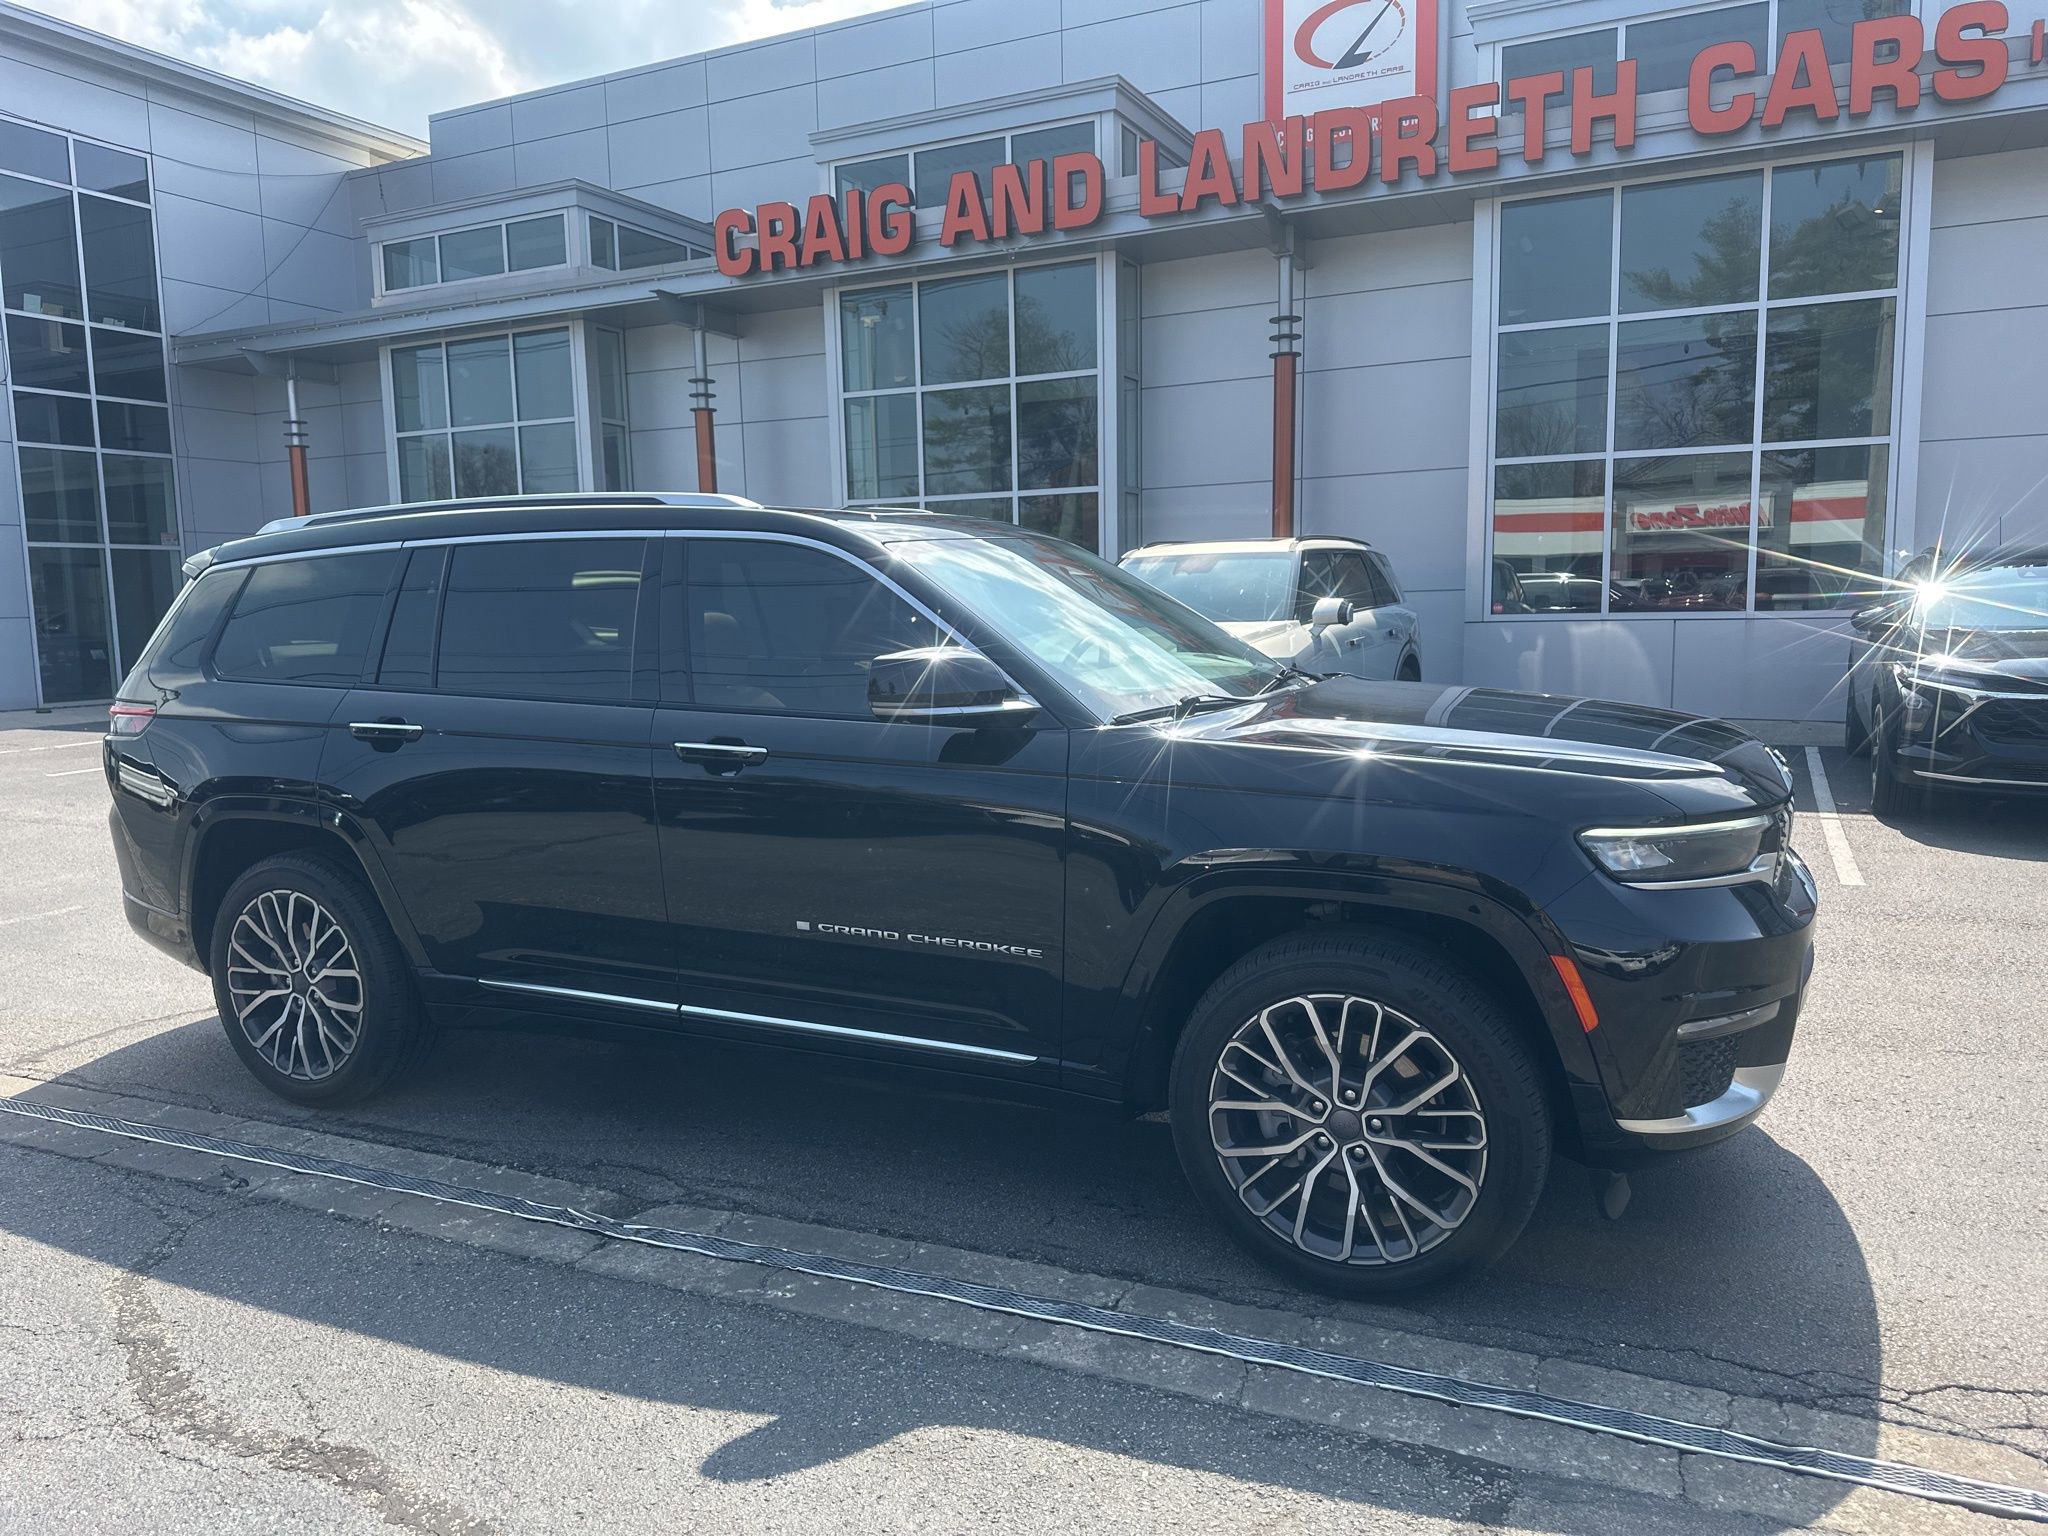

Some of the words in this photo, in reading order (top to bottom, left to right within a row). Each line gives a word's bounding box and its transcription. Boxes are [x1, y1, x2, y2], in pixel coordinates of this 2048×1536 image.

[1332, 69, 1378, 83] LANDRETH
[713, 183, 915, 277] CRAIG
[940, 152, 1105, 248] AND
[1139, 58, 1637, 218] LANDRETH
[1687, 0, 2009, 136] CARS
[817, 922, 900, 941] GRAND
[906, 933, 1043, 959] CHEROKEE
